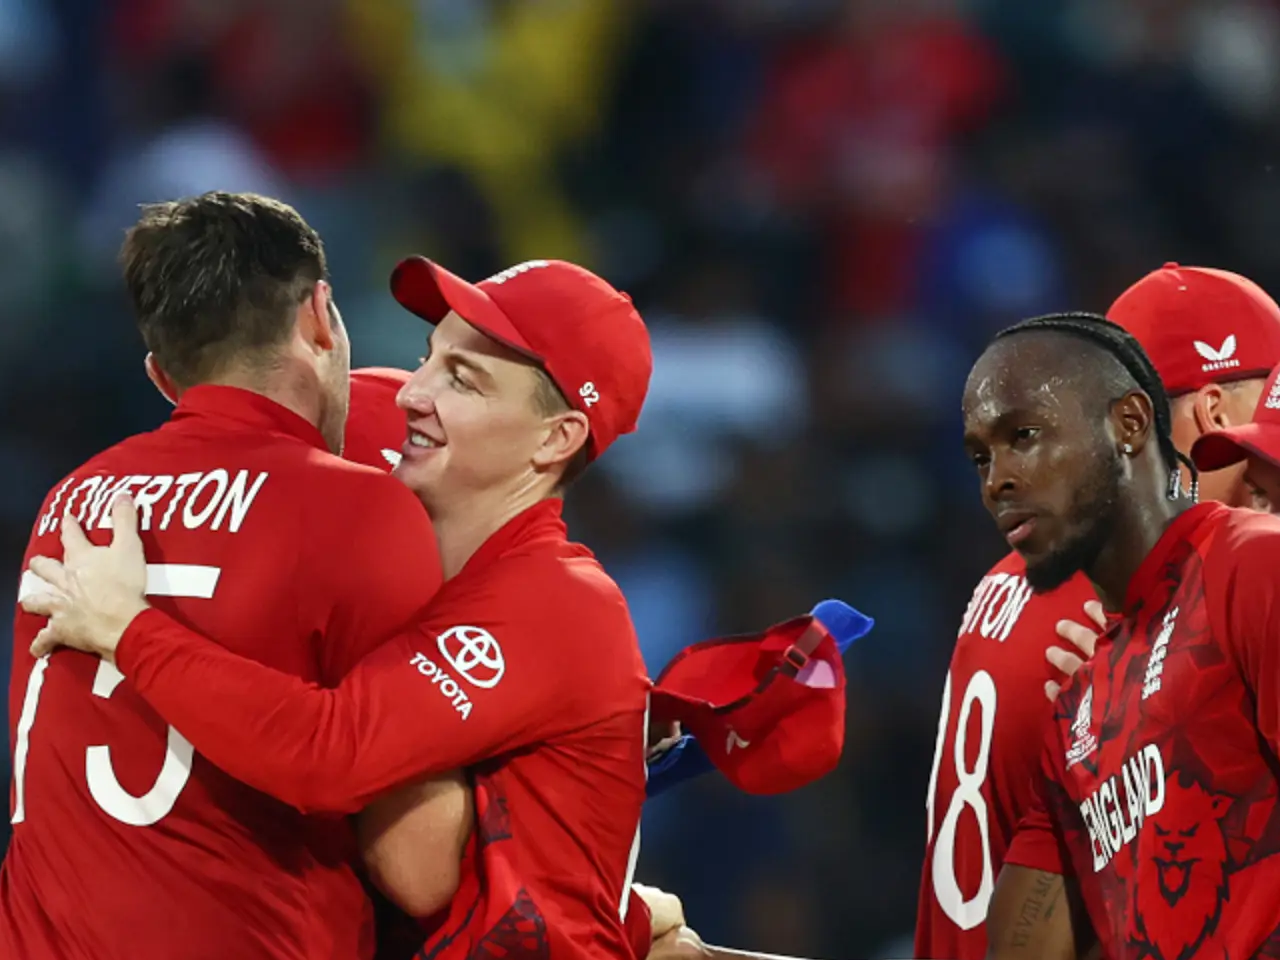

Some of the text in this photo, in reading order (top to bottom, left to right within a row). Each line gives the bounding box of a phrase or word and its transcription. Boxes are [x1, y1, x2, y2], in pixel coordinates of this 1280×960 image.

[579, 381, 600, 408] 92
[409, 651, 473, 721] TOYOTA
[1079, 743, 1165, 873] ENGLAND
